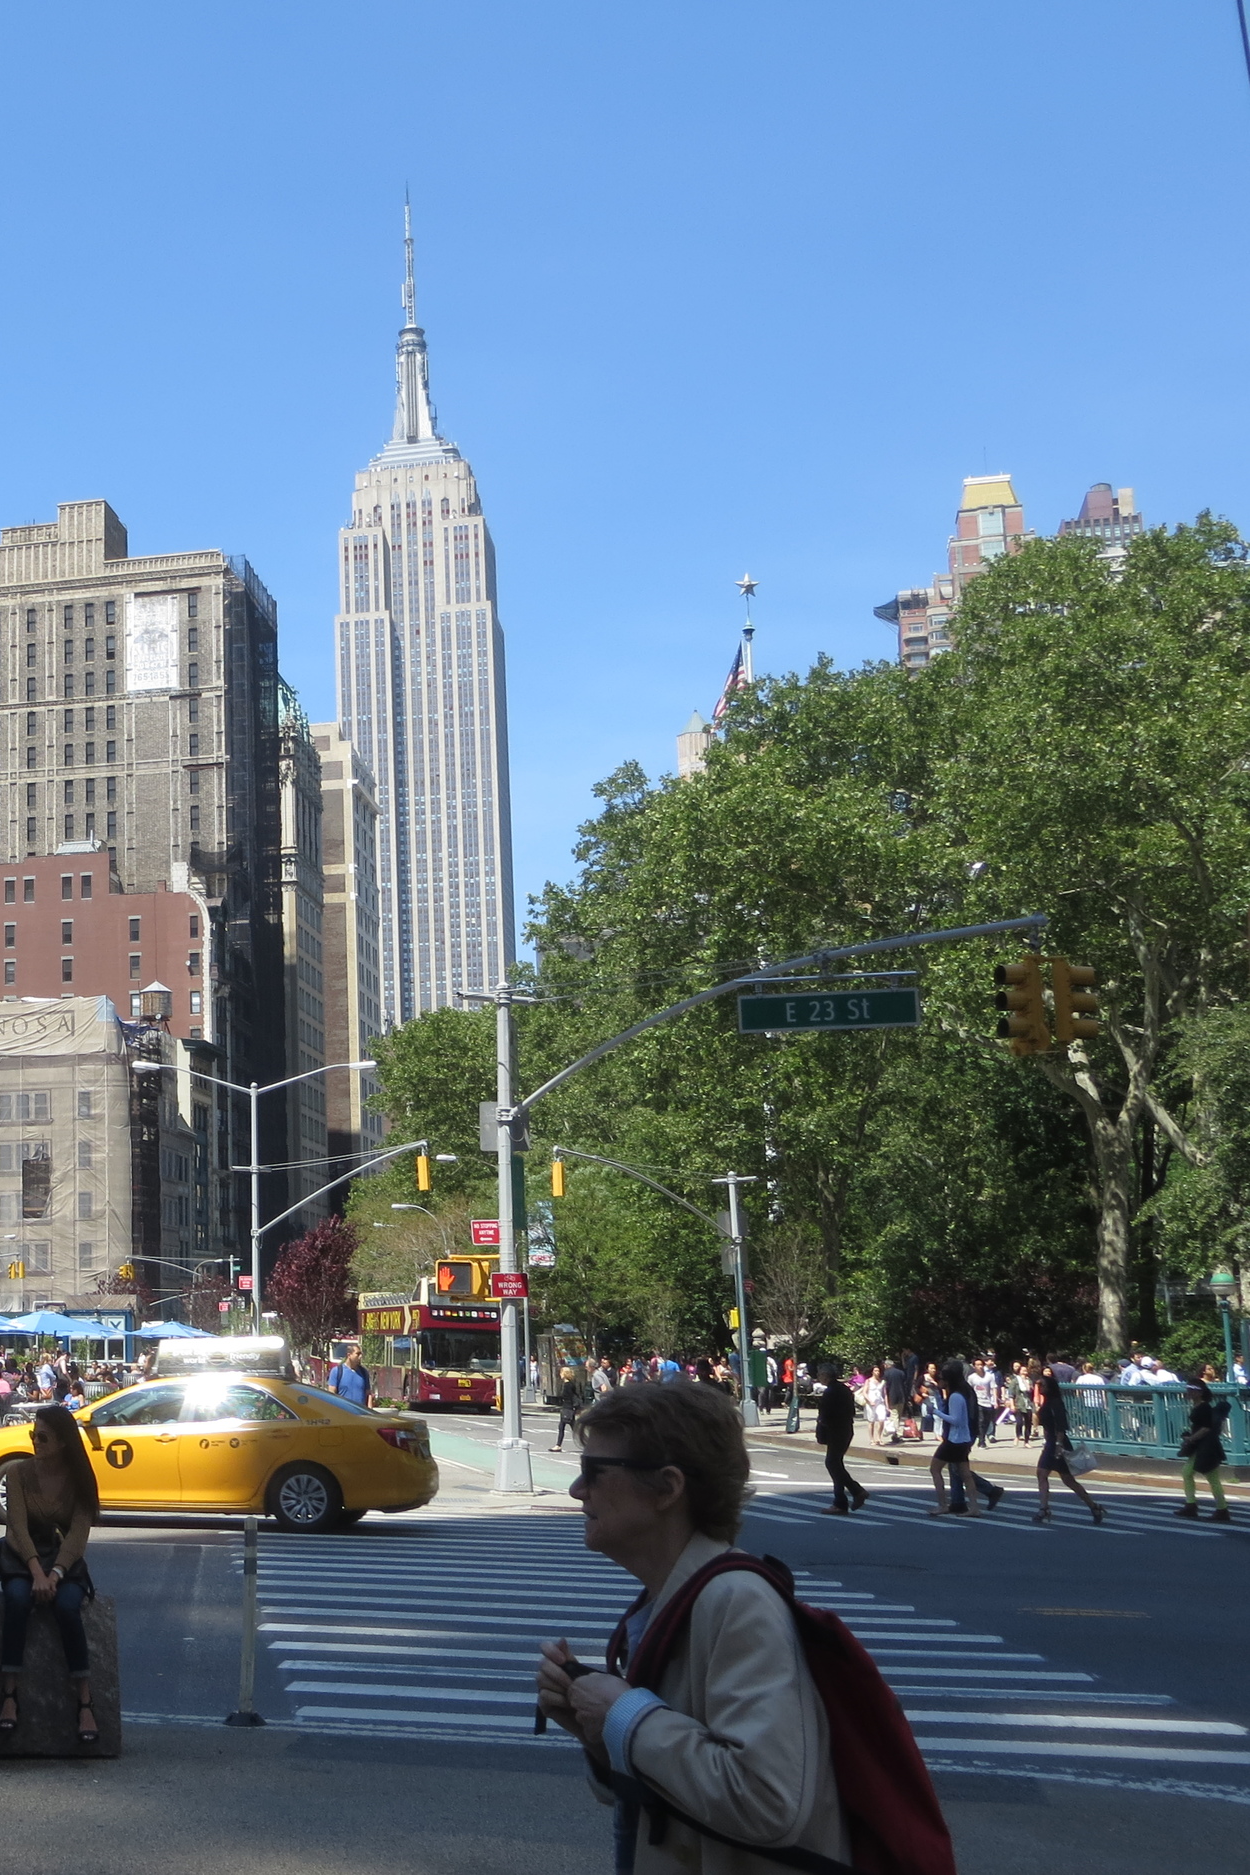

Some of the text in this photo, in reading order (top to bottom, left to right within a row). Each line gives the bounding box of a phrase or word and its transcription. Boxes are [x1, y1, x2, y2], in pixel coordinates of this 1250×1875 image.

[785, 998, 871, 1023] E 23 St
[111, 1444, 128, 1465] T
